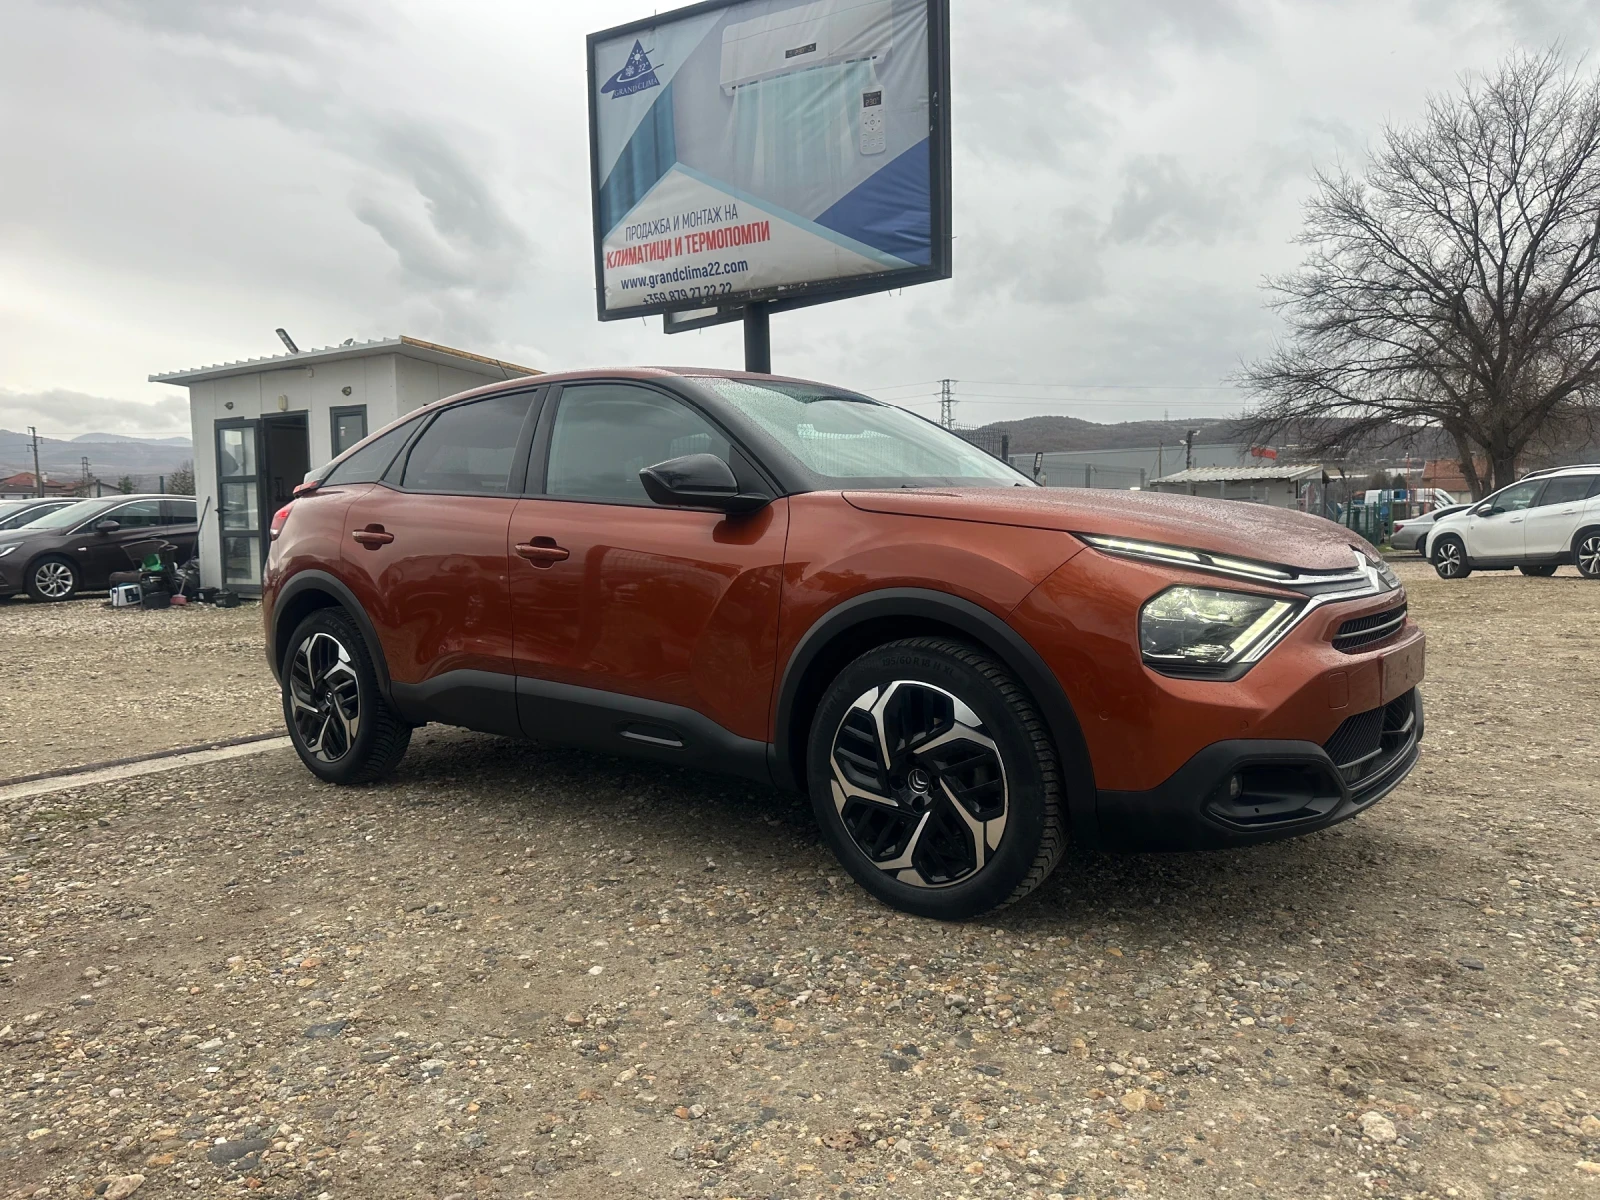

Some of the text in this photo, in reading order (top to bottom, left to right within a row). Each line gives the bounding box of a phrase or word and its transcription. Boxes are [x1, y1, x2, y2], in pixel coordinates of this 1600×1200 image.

[625, 203, 738, 242] ПРОДАЖБА И МОНТАЖ НА
[606, 220, 771, 269] КЛИМАТИЦИ И ТЕРМОПОМПИ
[621, 259, 748, 290] www.grandclima22.com
[669, 289, 688, 301] 879
[882, 656, 911, 667] 195/60
